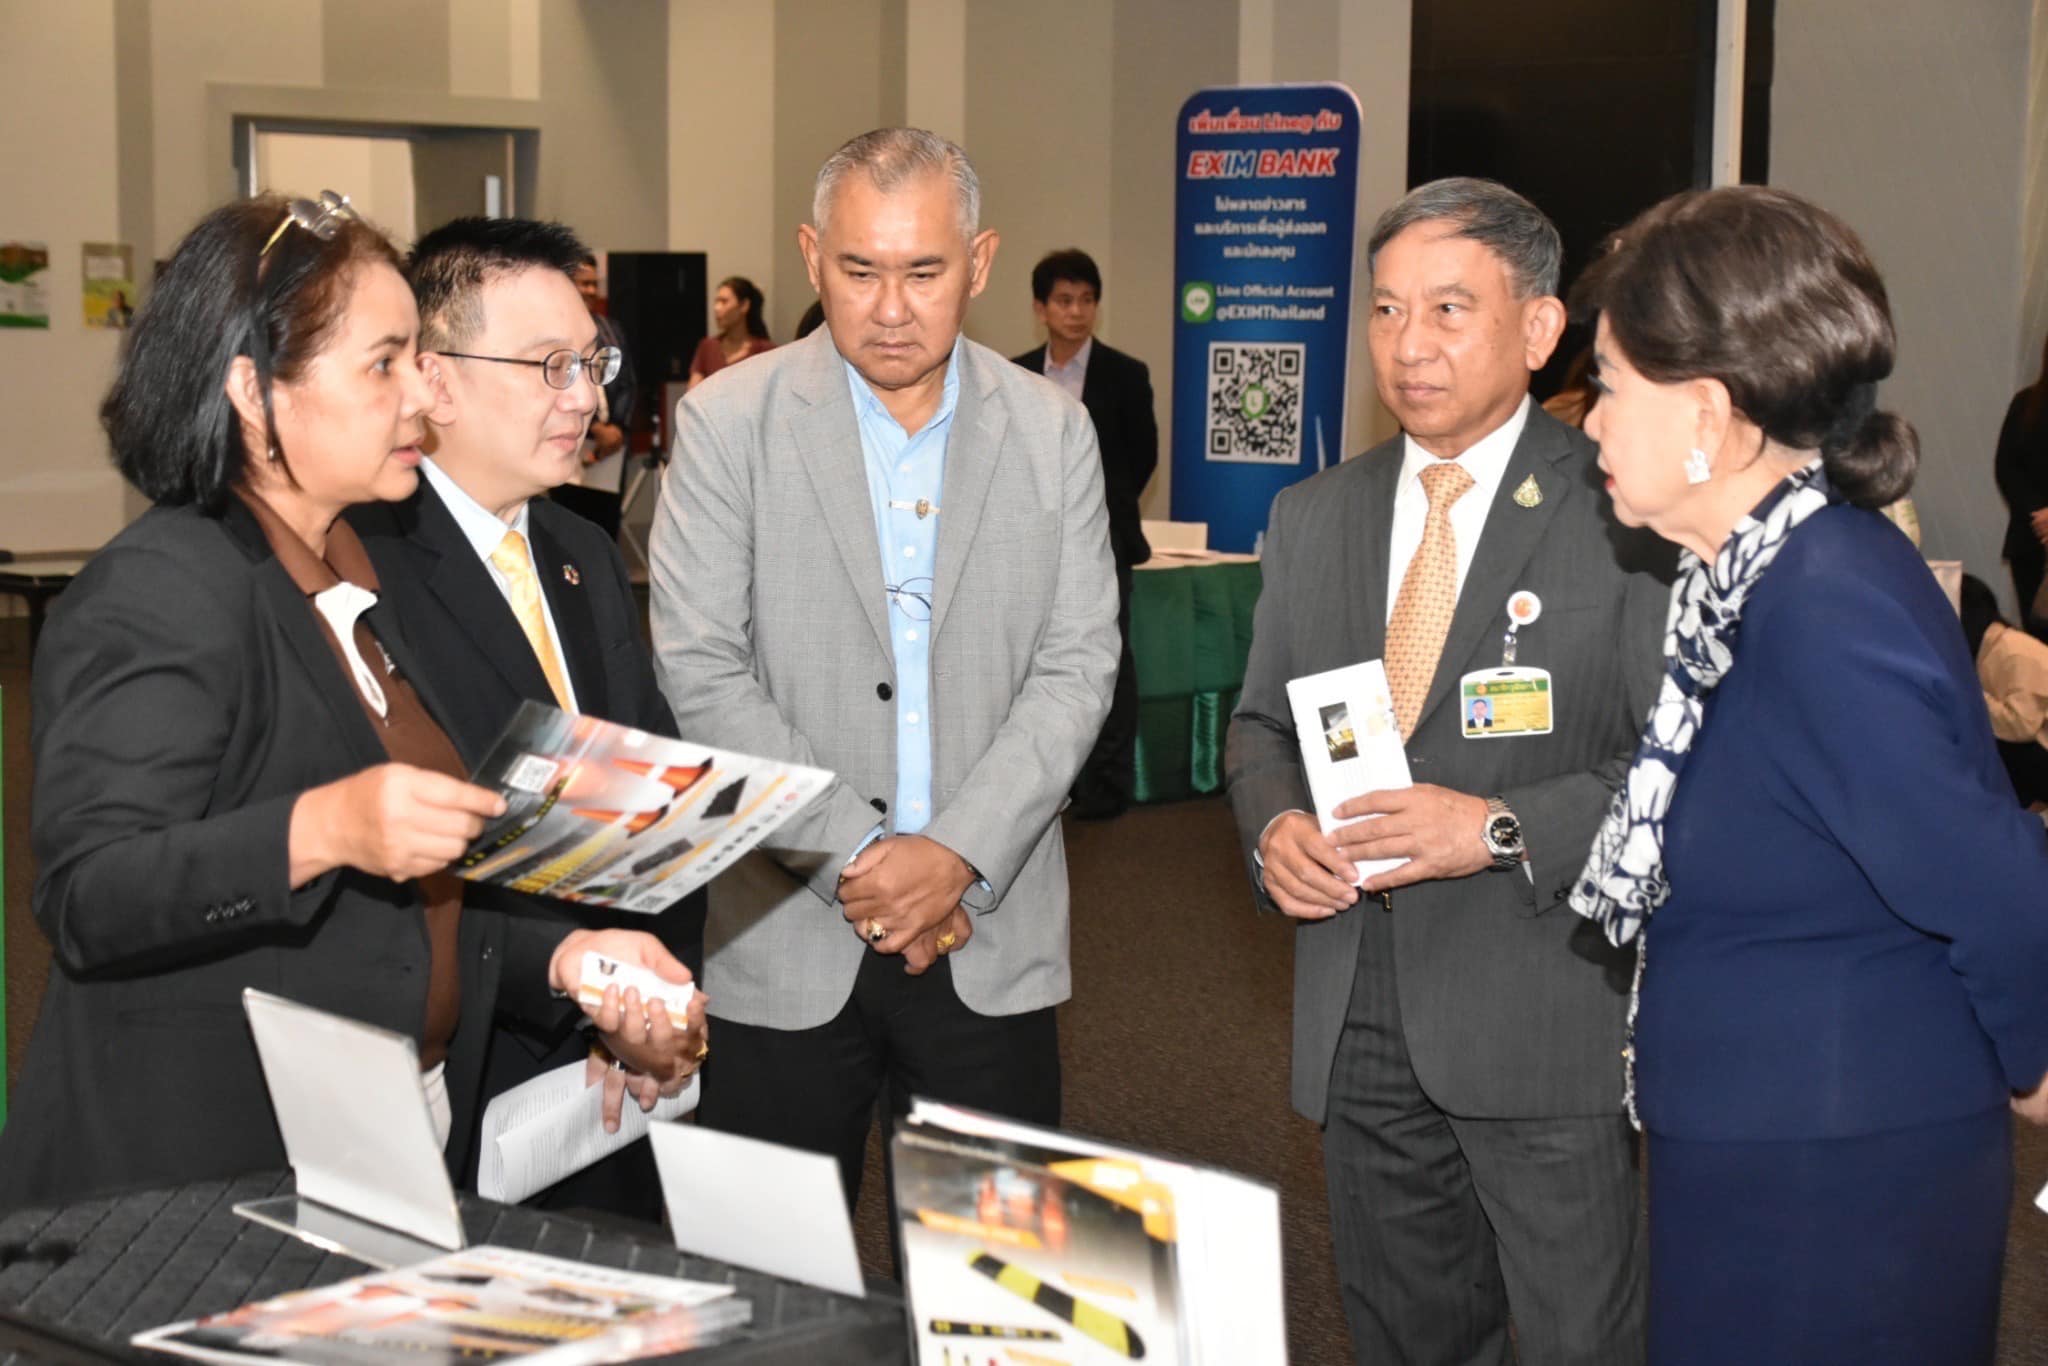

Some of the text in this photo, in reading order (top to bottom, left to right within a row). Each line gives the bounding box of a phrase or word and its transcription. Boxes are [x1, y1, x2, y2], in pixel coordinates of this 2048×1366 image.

[1187, 147, 1340, 179] EXIM BANK
[1216, 284, 1335, 298] Line Official Account
[1216, 304, 1326, 322] @EXIMThailand
